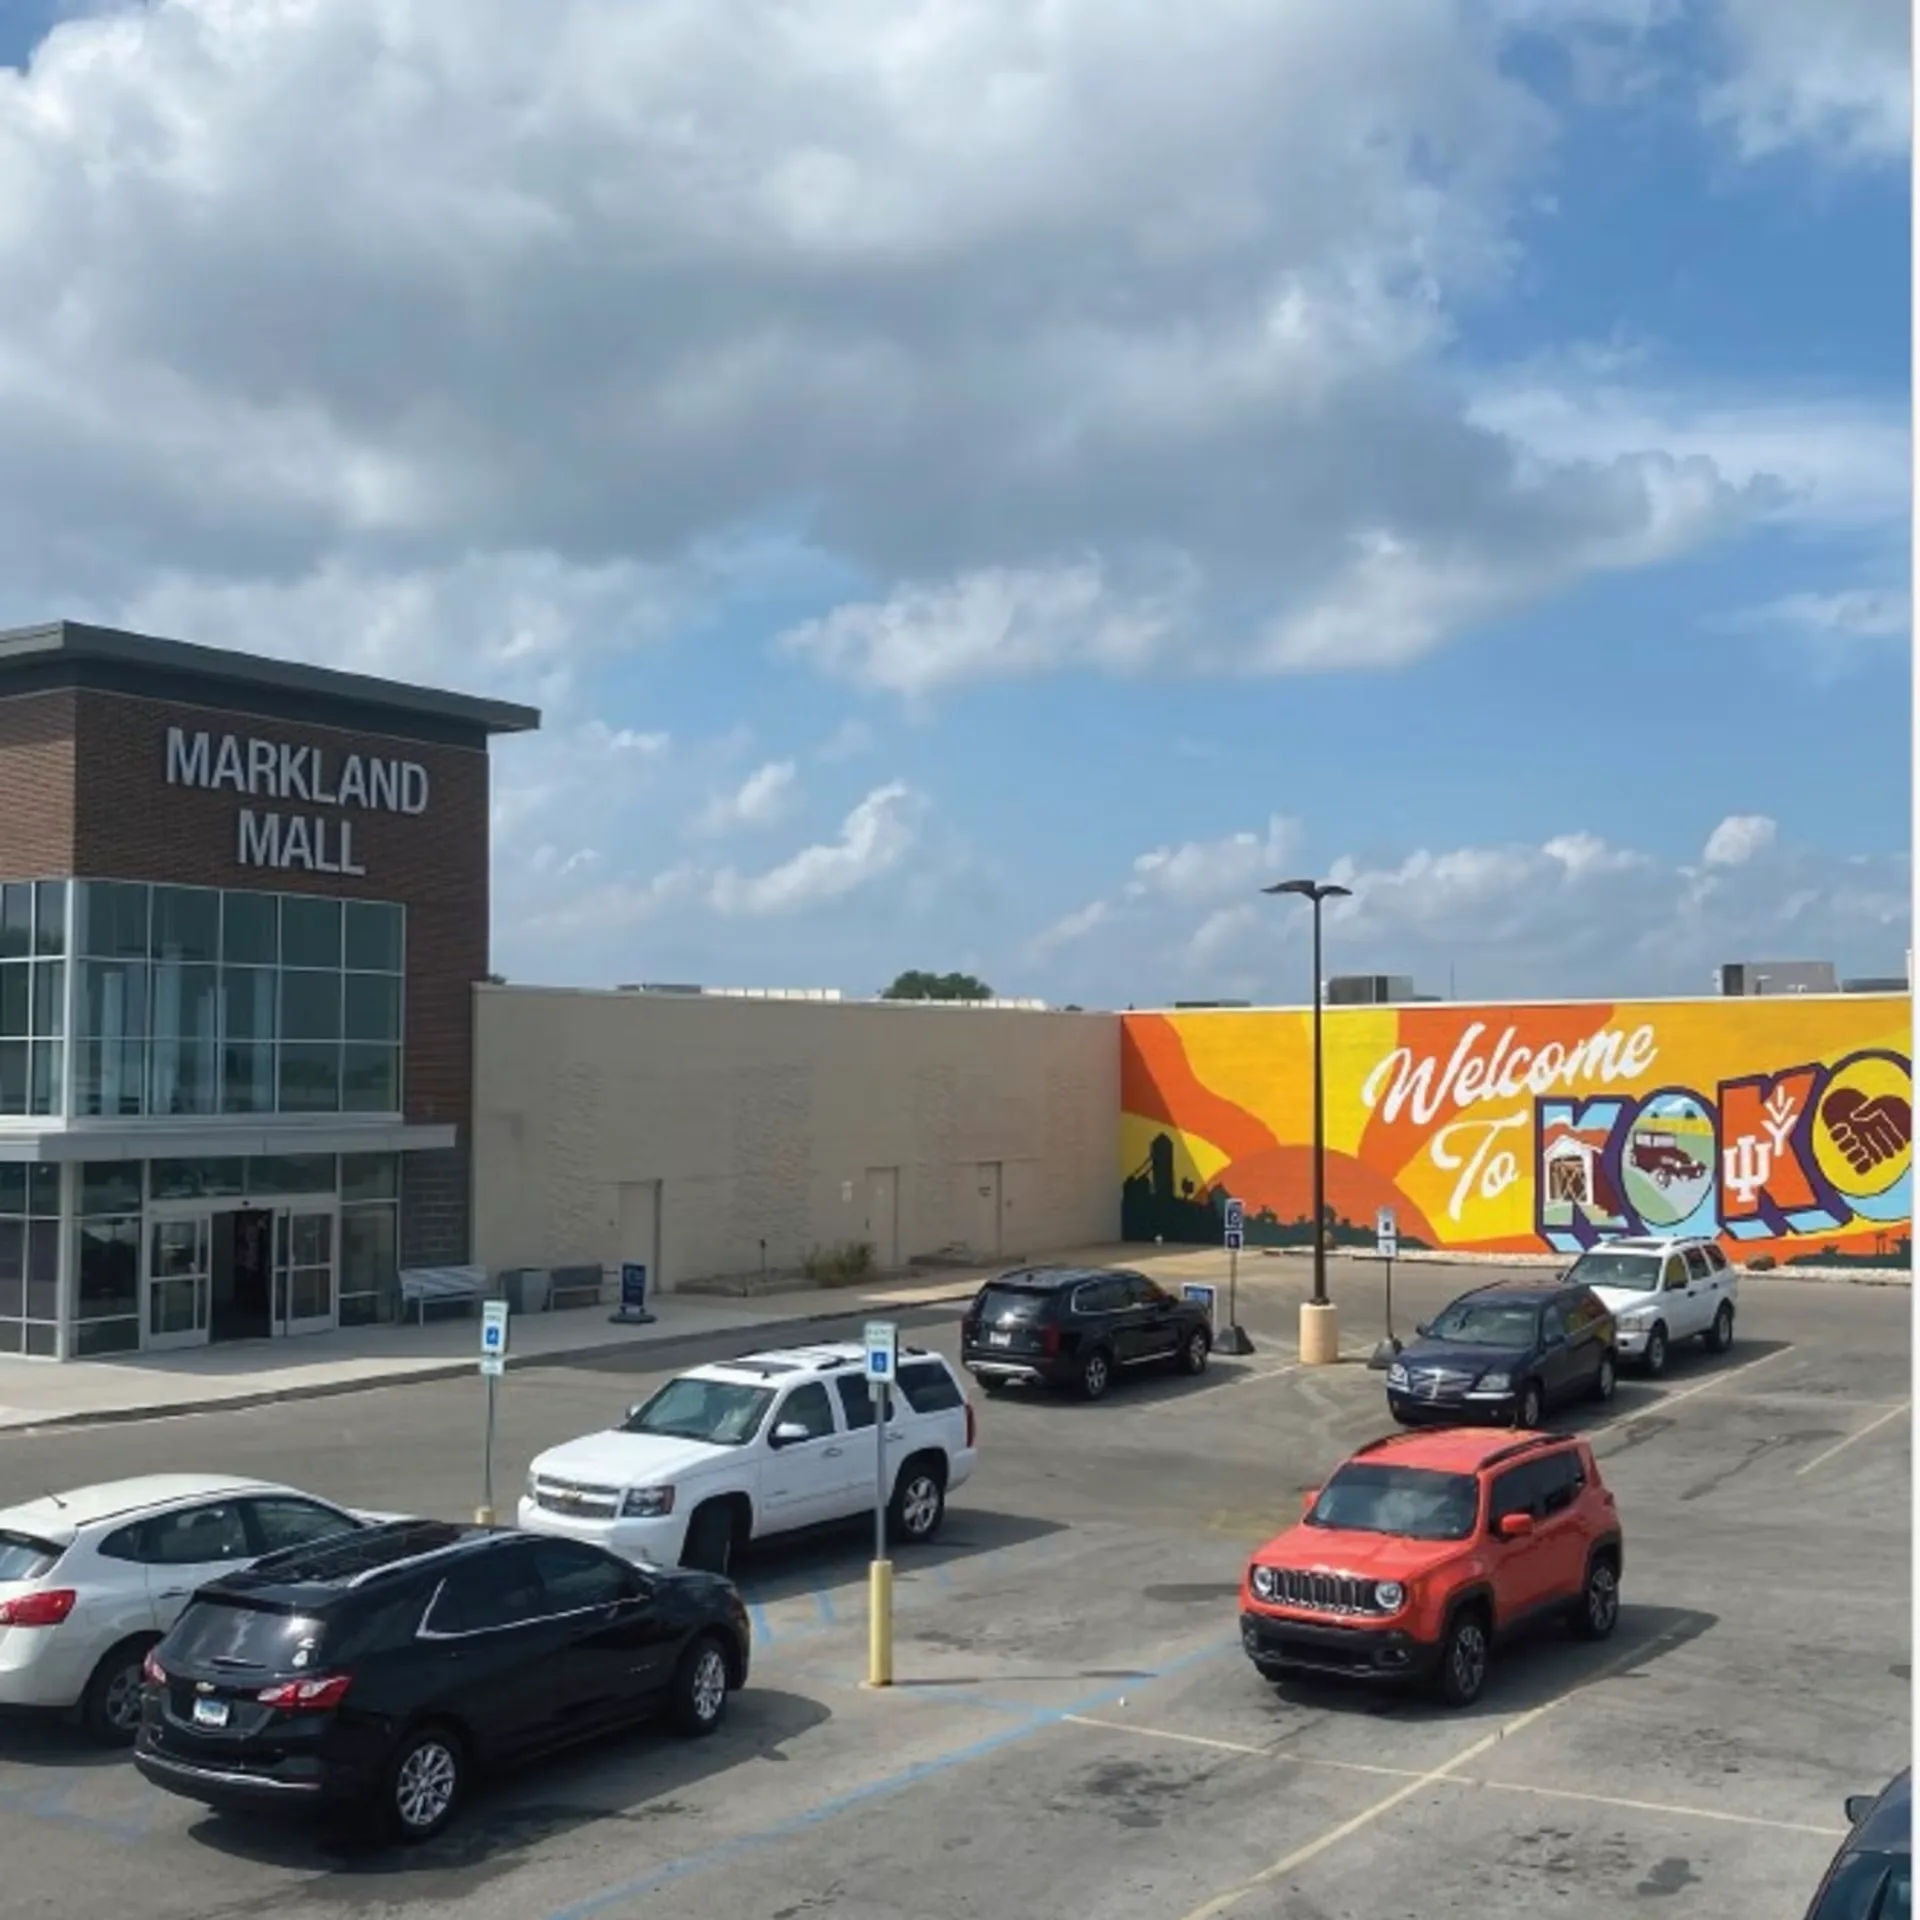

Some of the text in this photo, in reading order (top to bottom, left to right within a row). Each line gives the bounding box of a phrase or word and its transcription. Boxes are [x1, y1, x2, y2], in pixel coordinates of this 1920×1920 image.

[166, 726, 429, 815] MARKLAND
[237, 808, 367, 877] MALL
[1361, 1021, 1659, 1125] Welcome
[1430, 1110, 1529, 1221] To
